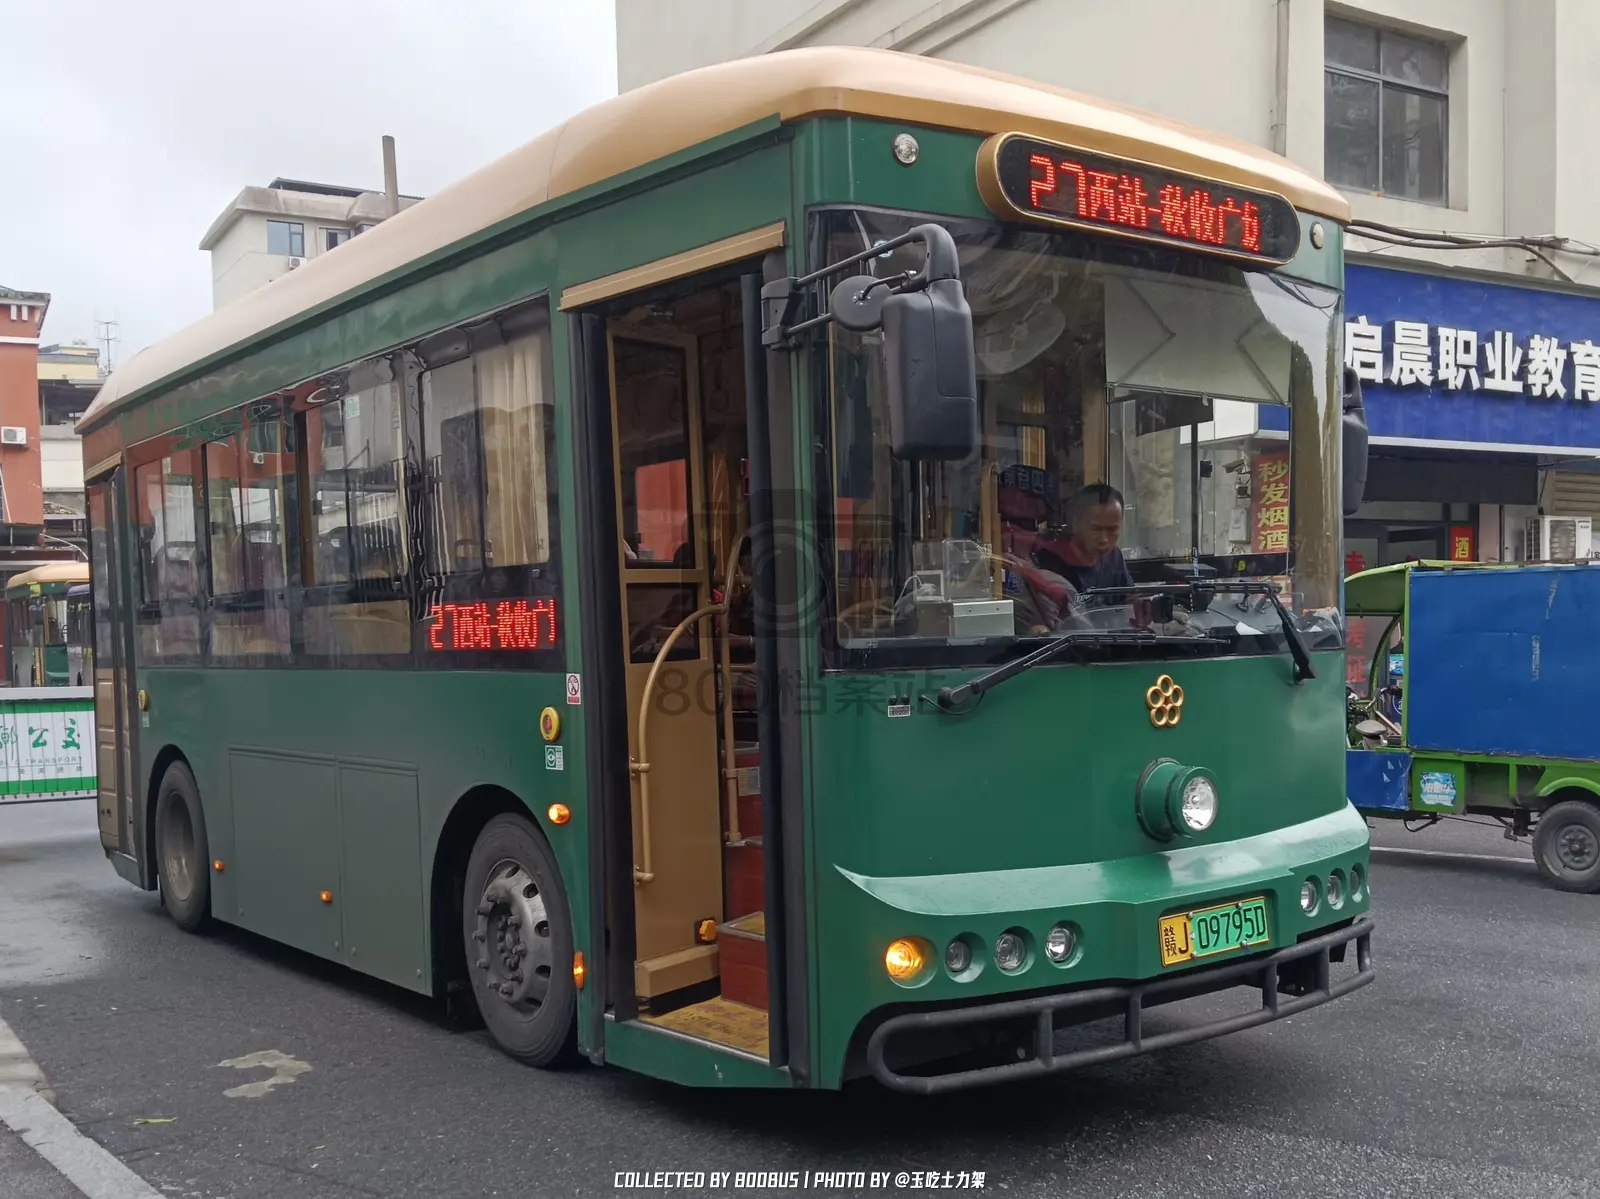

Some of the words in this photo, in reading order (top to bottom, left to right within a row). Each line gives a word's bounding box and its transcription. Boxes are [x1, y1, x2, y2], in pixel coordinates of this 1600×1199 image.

[1344, 315, 1600, 401] 启晨职业教育
[1257, 460, 1289, 550] 秒发烟酒
